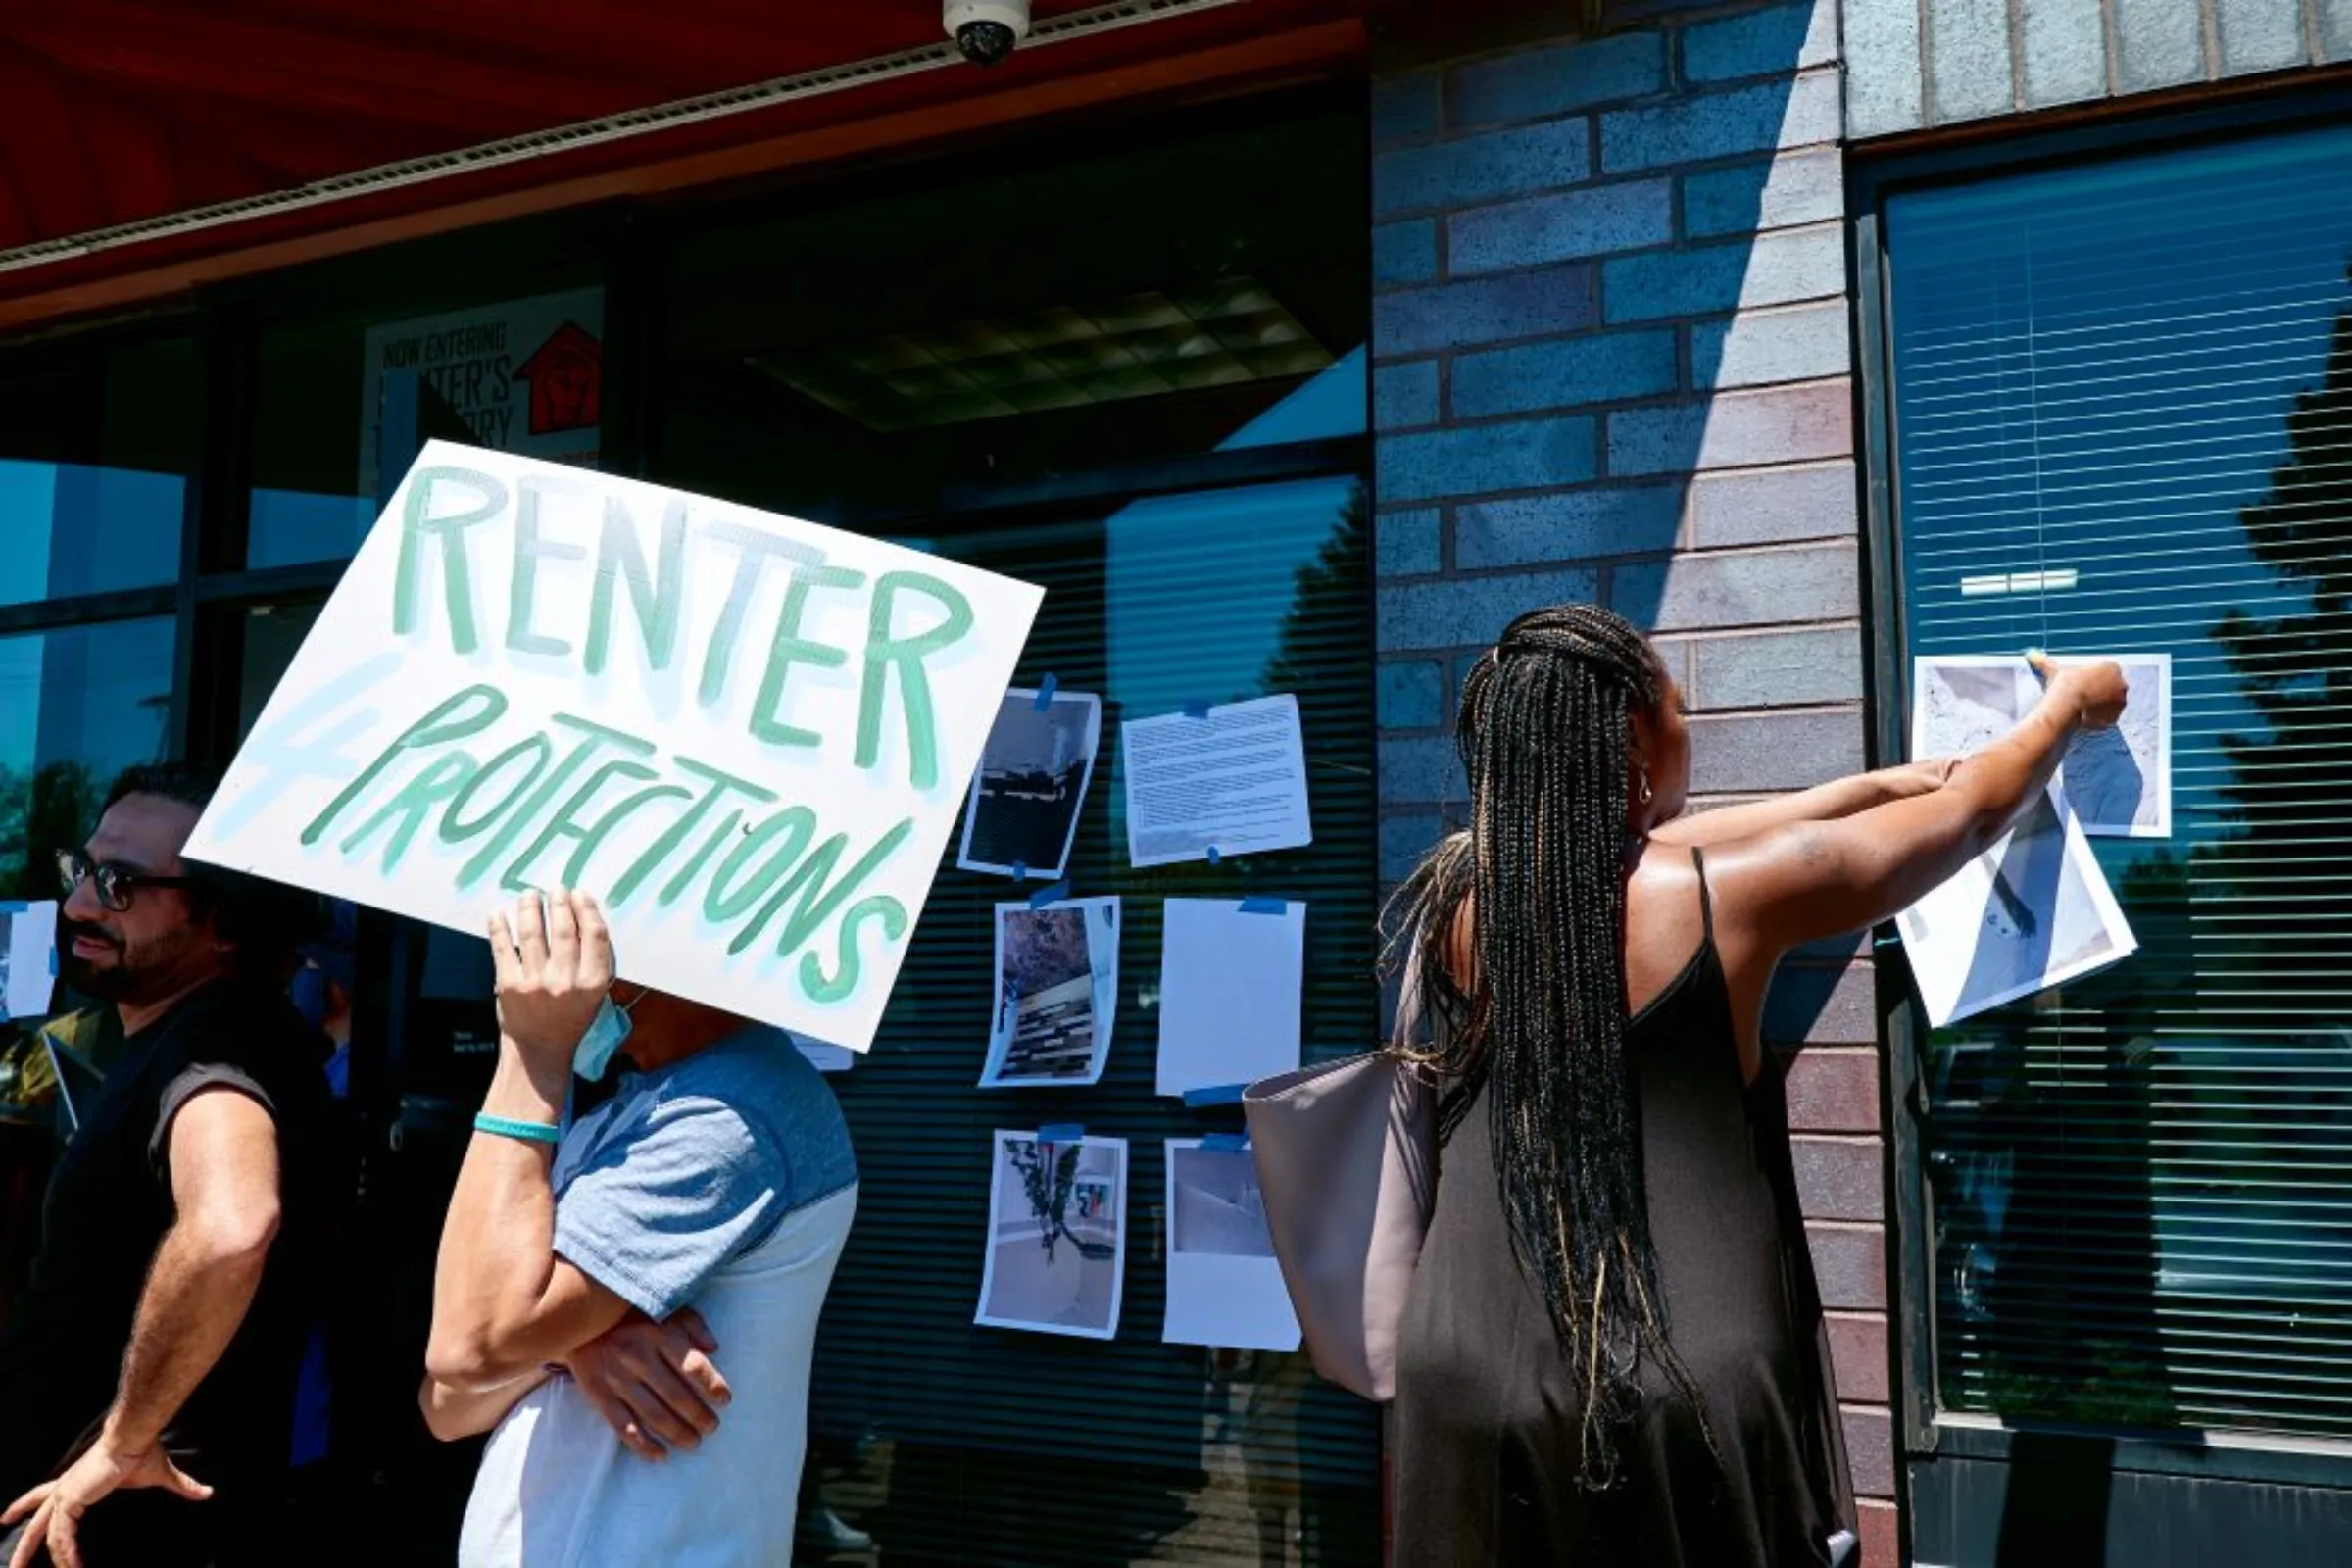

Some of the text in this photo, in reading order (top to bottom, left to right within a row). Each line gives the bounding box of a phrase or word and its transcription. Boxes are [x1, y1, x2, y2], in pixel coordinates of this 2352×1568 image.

[382, 320, 508, 369] NOW ENTERING
[393, 466, 976, 792] RENTER
[299, 682, 914, 1004] PROTECTIONS
